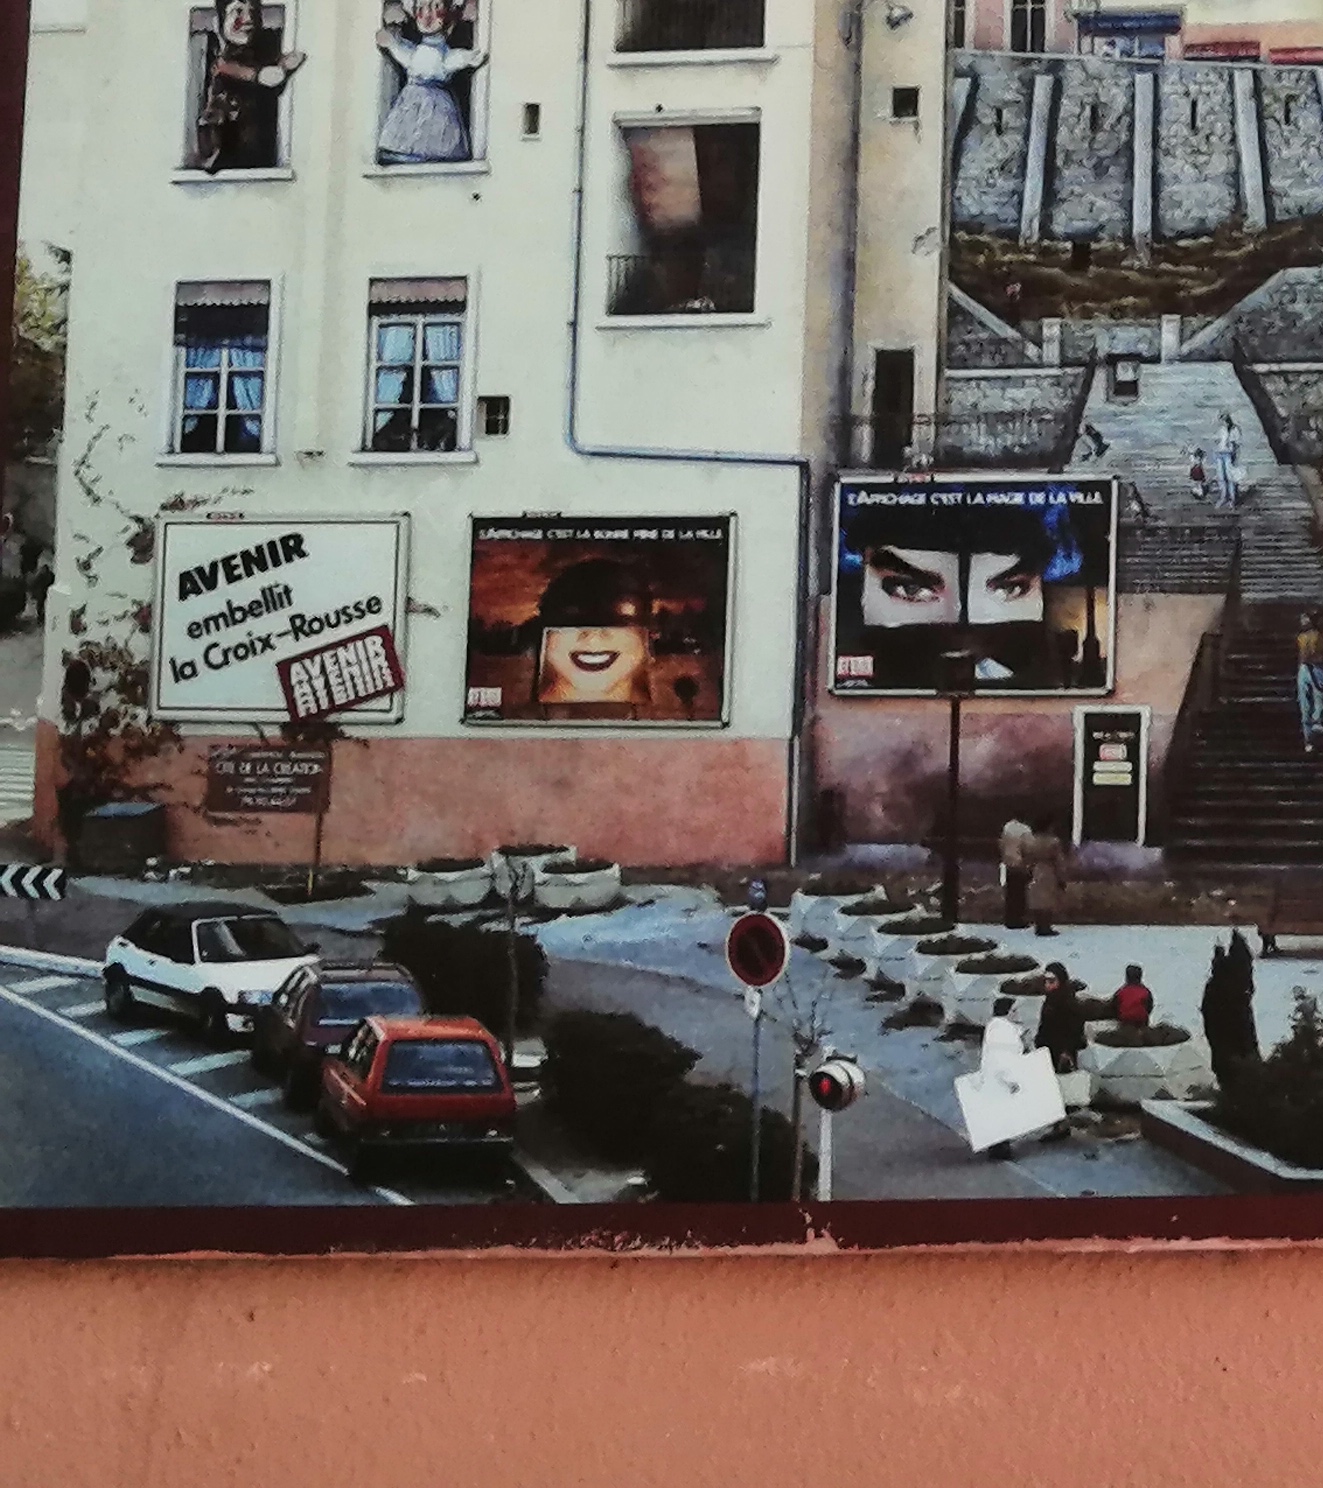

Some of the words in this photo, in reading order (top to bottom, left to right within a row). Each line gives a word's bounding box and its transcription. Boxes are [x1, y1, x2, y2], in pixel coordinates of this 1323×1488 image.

[178, 532, 310, 601] AVENIR
[169, 656, 199, 684] la
[203, 595, 383, 671] Croix-Rousse
[187, 582, 294, 639] embellit
